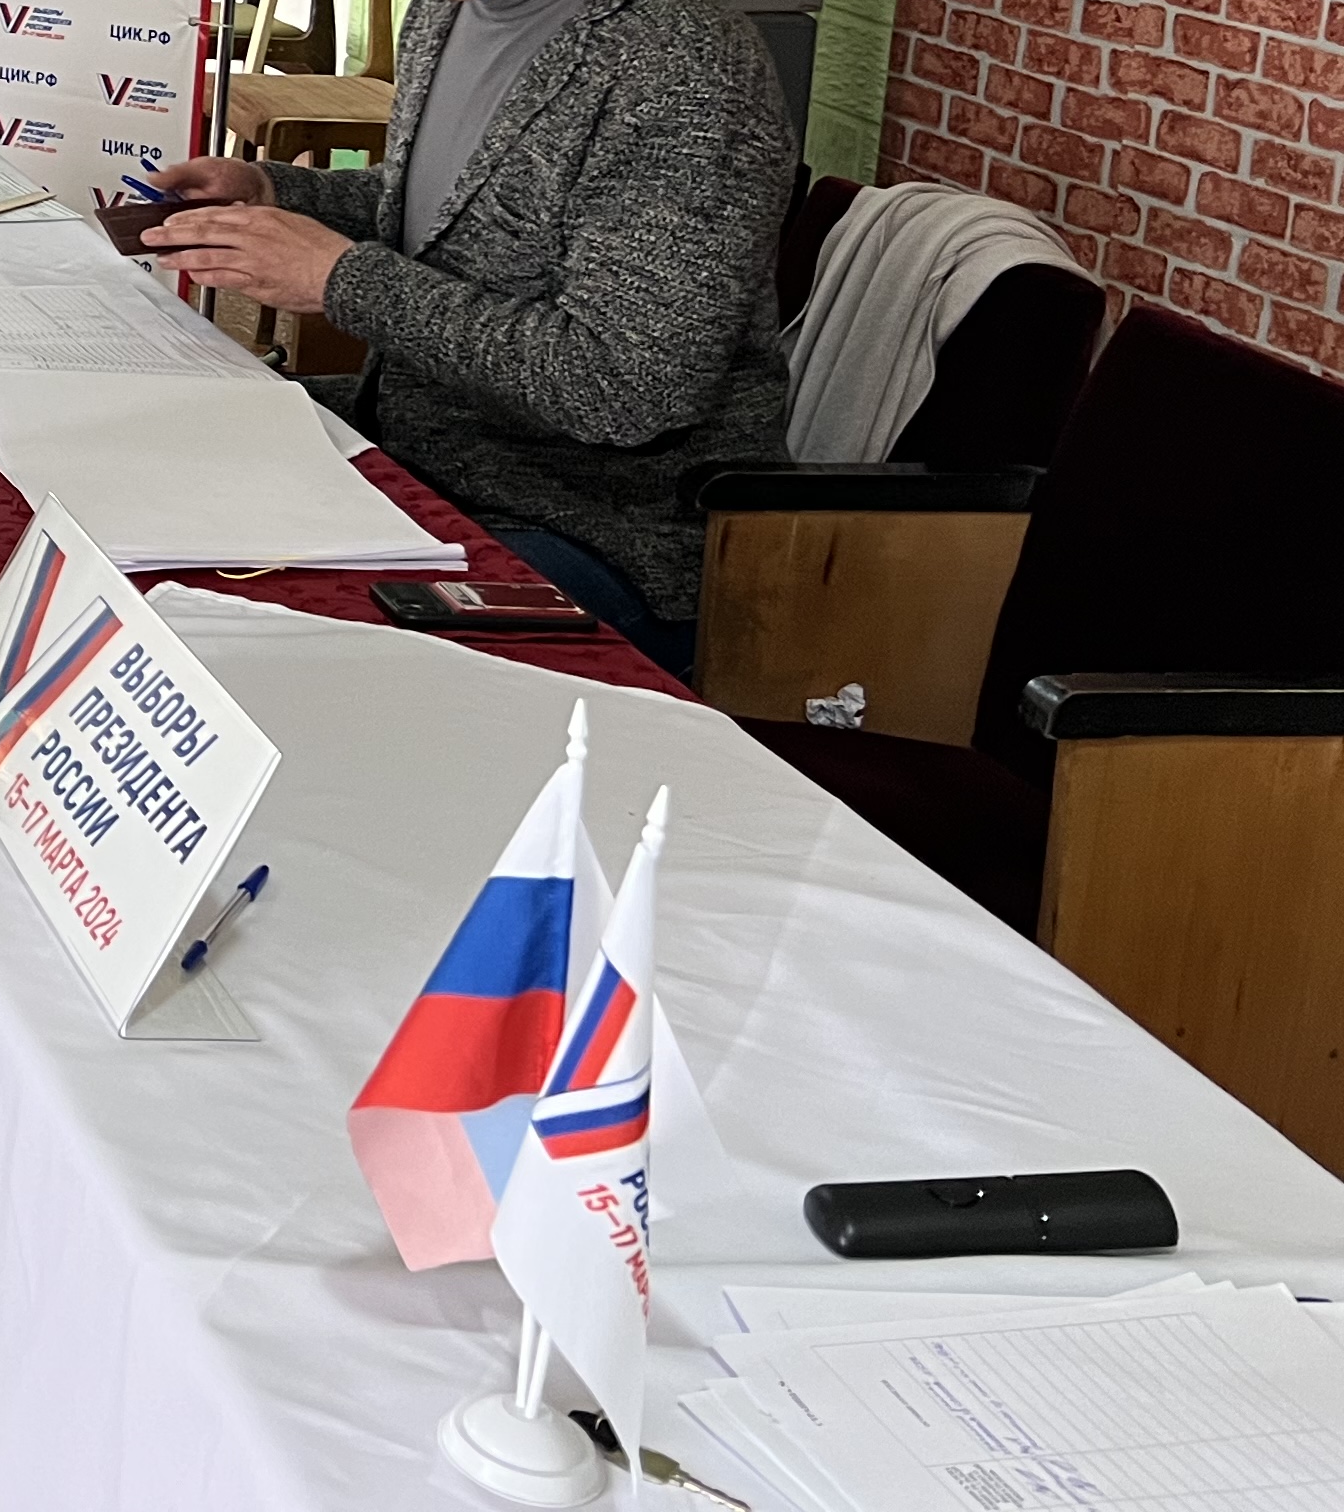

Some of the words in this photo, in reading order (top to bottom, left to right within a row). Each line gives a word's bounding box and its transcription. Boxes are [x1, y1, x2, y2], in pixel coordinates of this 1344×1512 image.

[0, 67, 57, 87] ЦИК.РФ
[110, 24, 170, 45] ЦИК.РФ
[101, 139, 162, 160] ЦИК.РФ
[109, 642, 219, 767] ВЫБОРЫ
[30, 728, 120, 848] РОССИИ
[68, 686, 209, 865] ПРЕЗИДЕНТА
[32, 818, 91, 904] МАРТА
[73, 883, 125, 951] 2024
